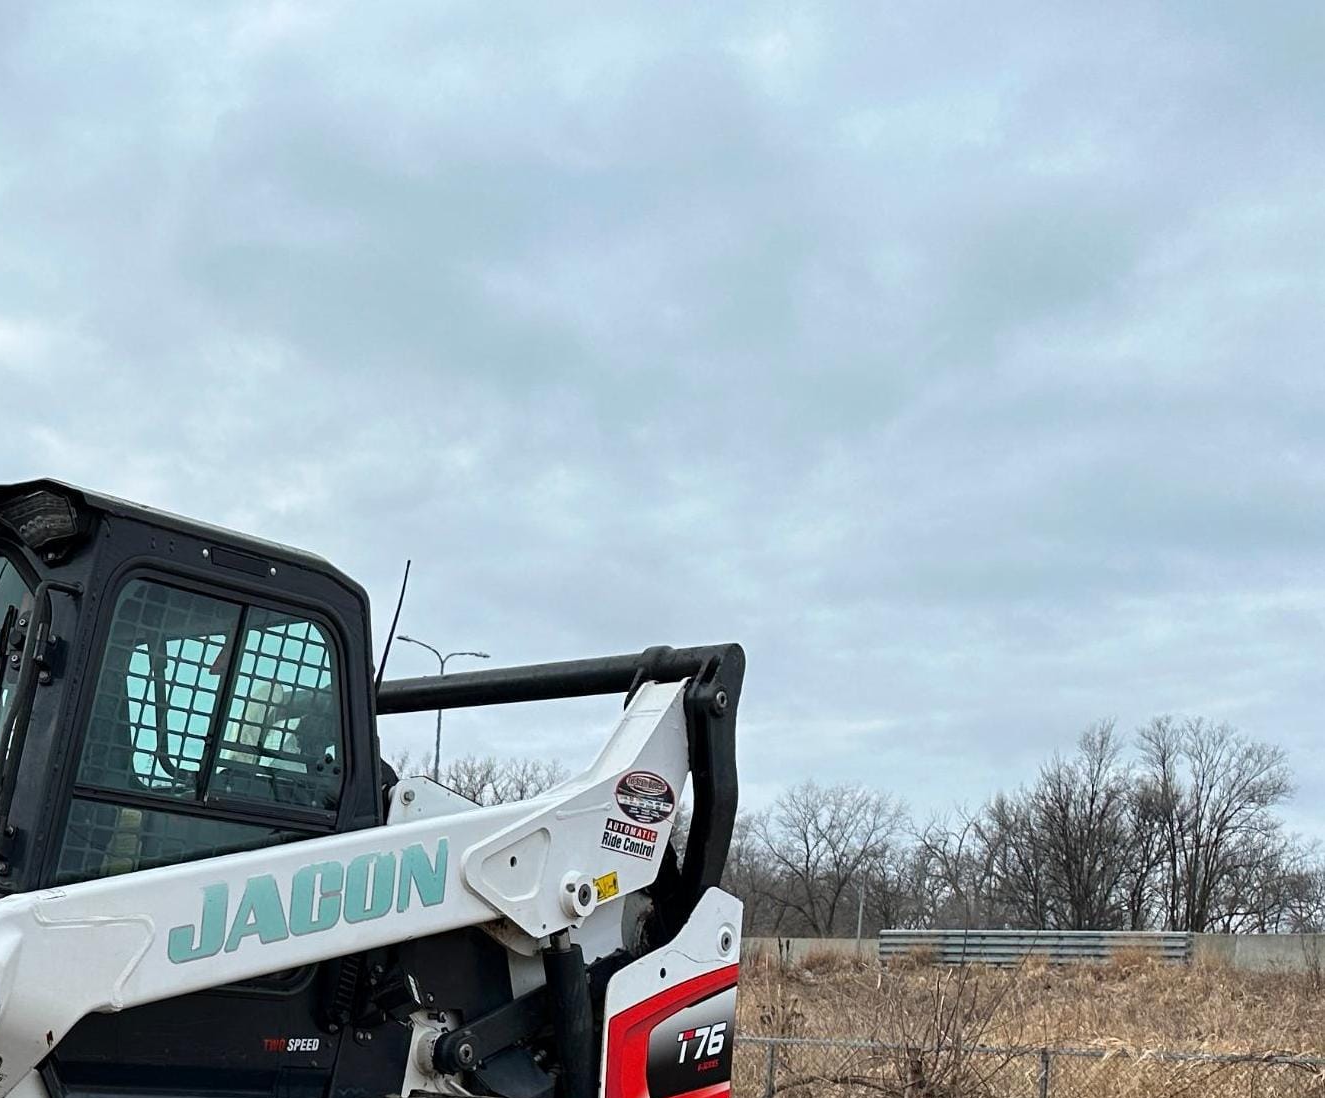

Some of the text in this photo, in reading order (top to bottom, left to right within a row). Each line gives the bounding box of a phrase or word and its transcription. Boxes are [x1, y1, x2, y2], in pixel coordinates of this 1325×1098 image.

[602, 831, 655, 858] Ride Control
[607, 820, 656, 842] AUTOMATIC
[168, 837, 449, 964] JACON
[286, 1038, 320, 1051] SPEED
[677, 1022, 727, 1064] T76
